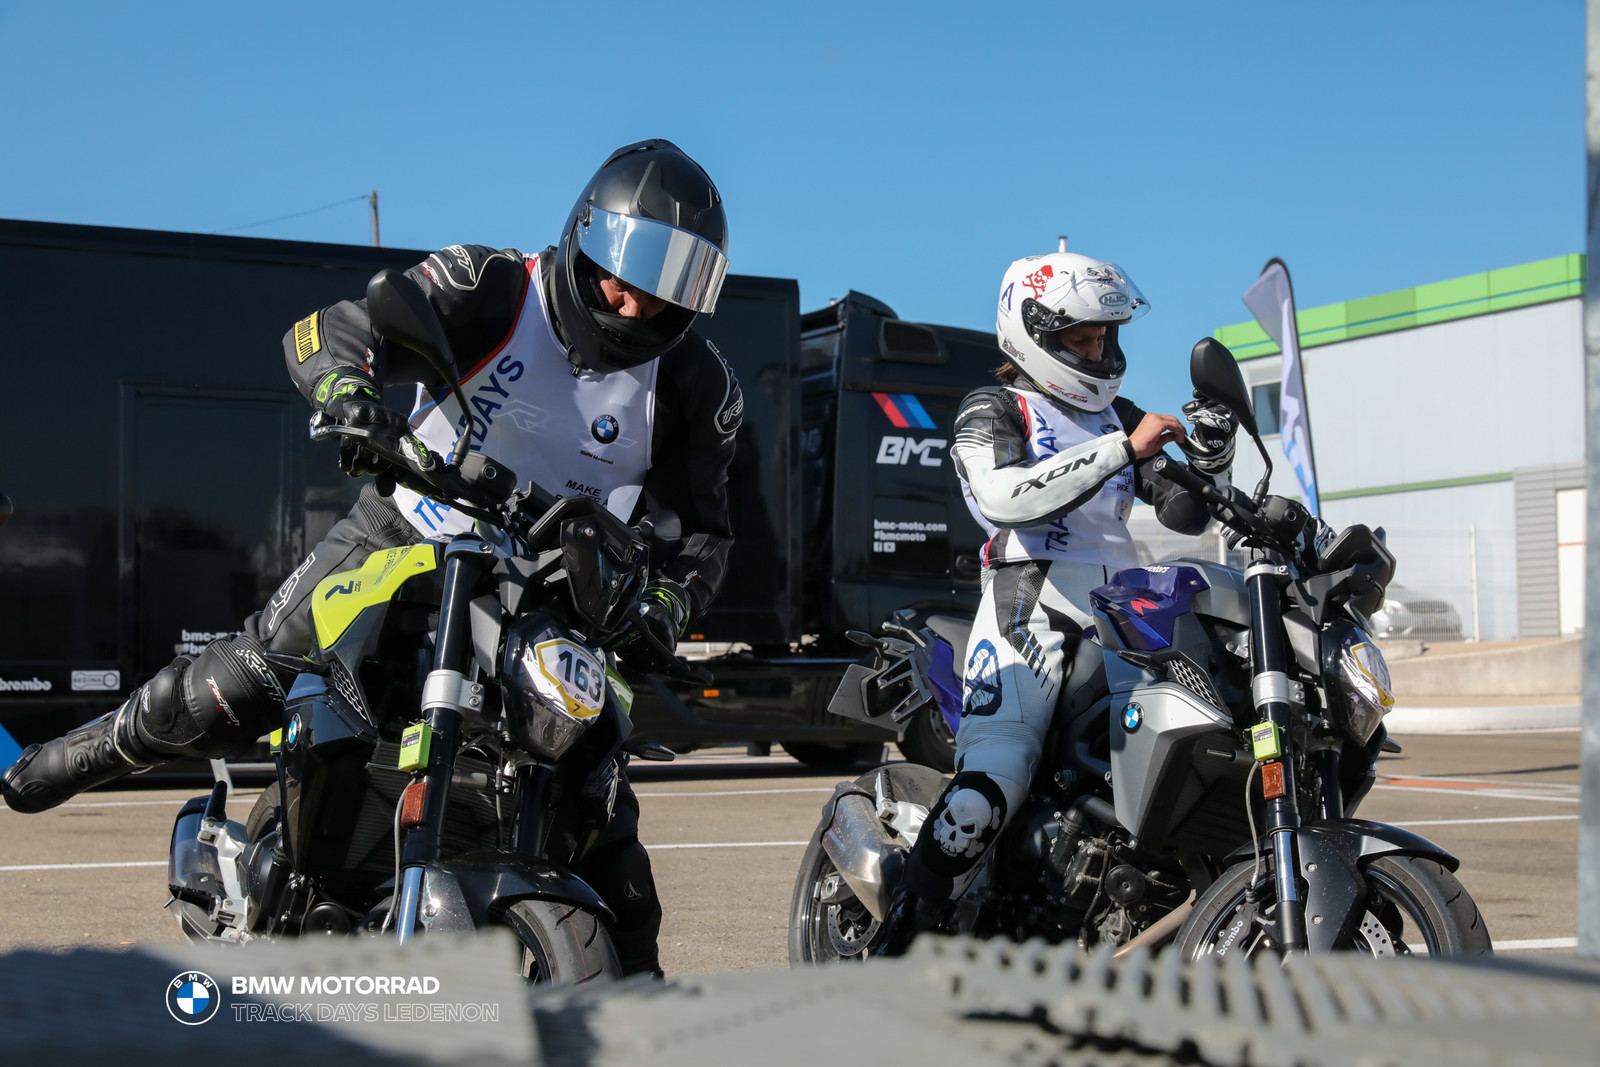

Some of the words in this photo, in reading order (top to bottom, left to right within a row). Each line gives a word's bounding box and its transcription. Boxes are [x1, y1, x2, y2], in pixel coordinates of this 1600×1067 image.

[1103, 293, 1126, 304] HJC
[875, 435, 948, 467] BMC
[565, 479, 602, 497] MAKE
[873, 518, 948, 532] bmc-moto.com
[873, 530, 927, 542] #bmcmoto
[558, 650, 603, 703] 163
[572, 703, 581, 712] 7
[1216, 920, 1244, 956] brembo
